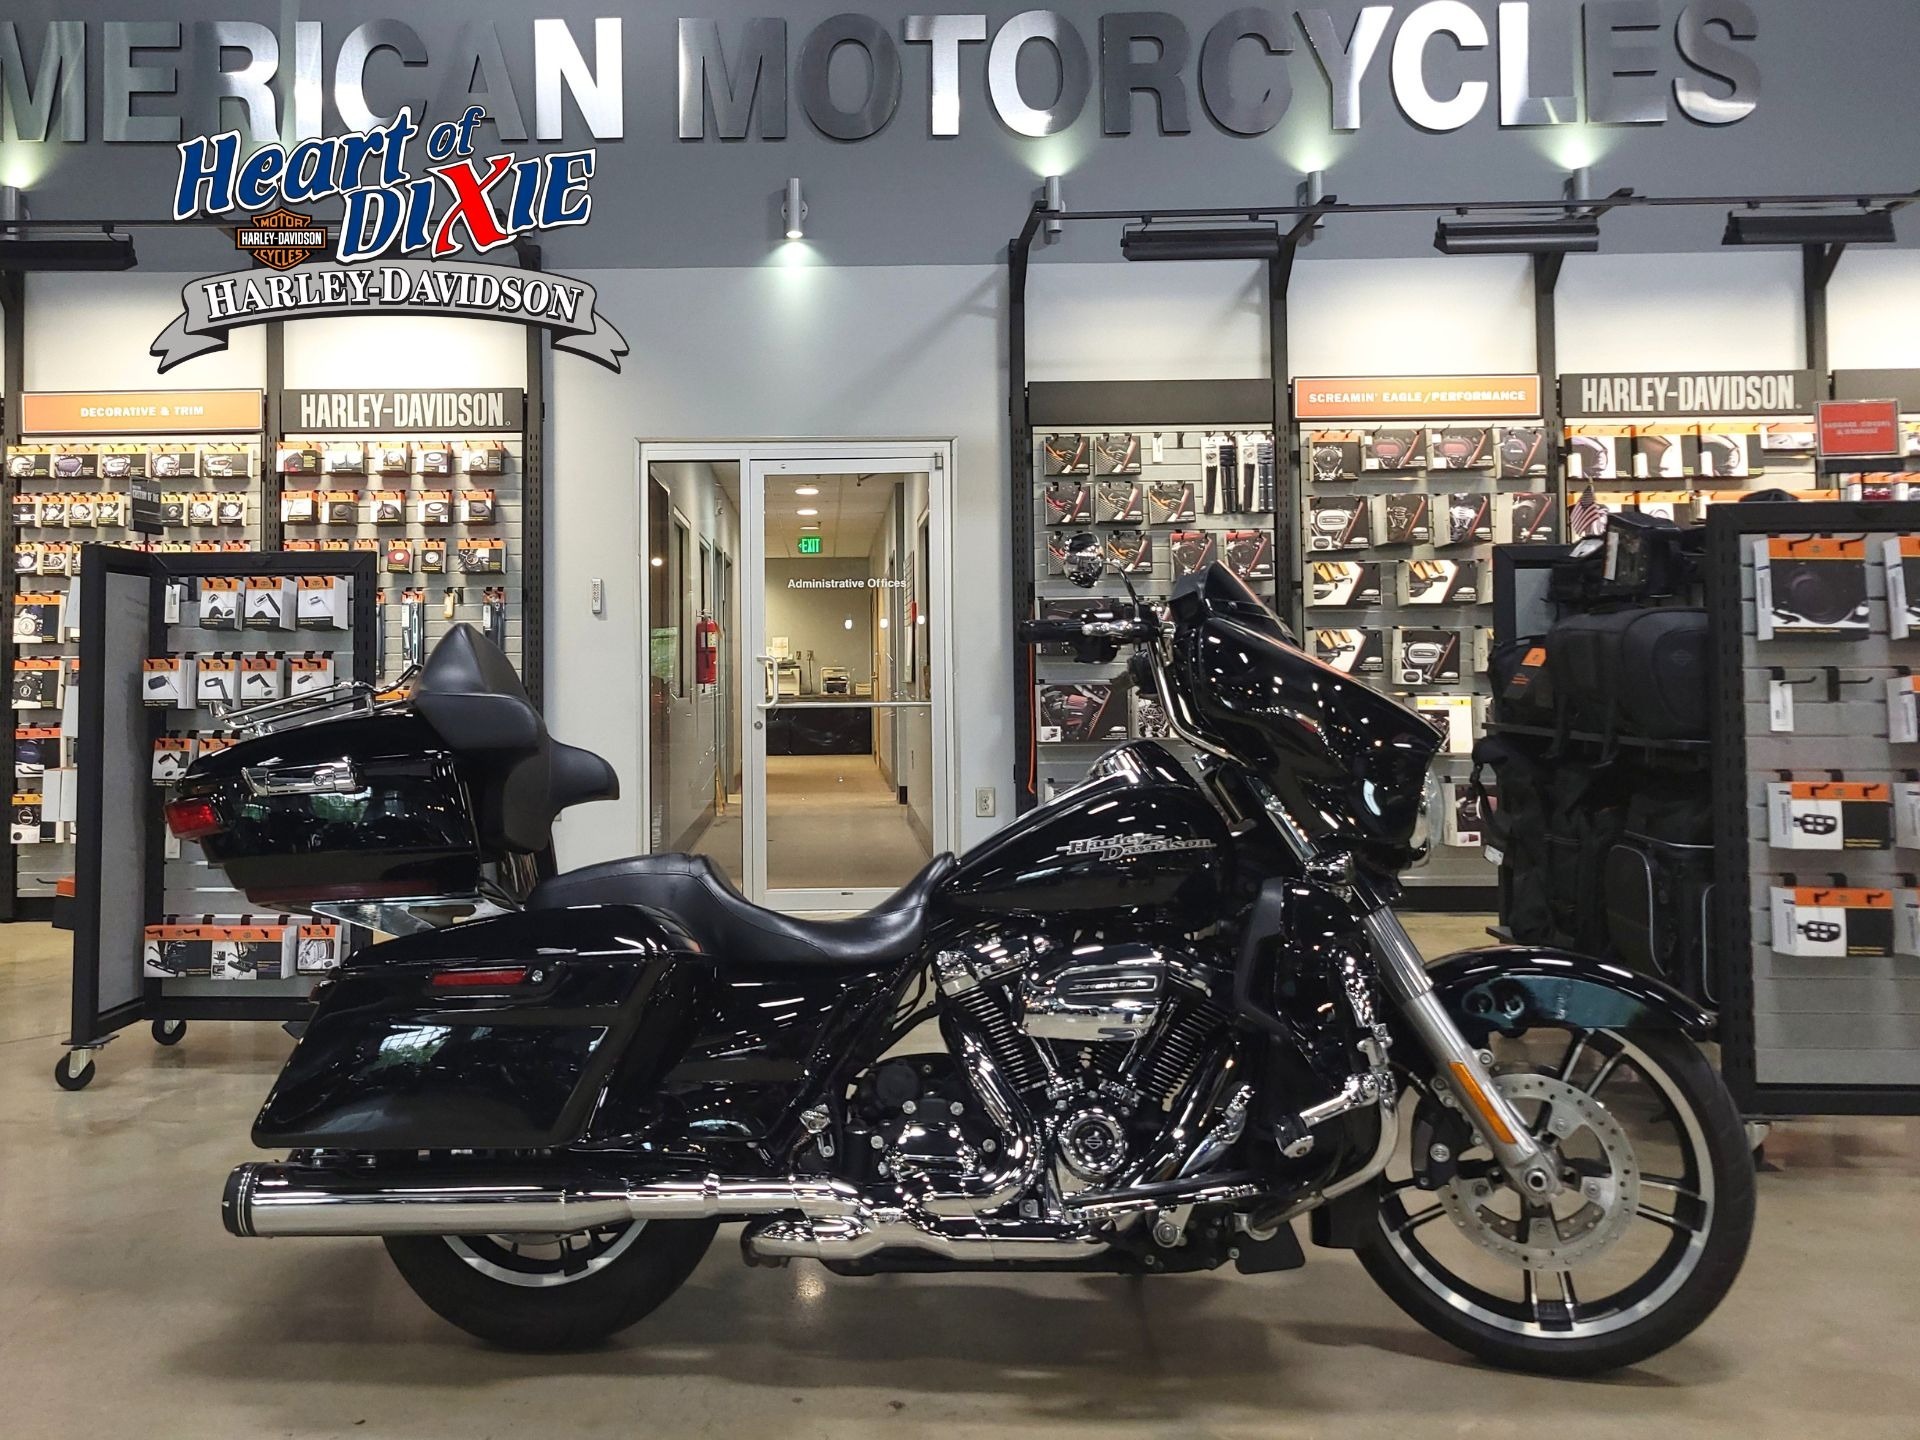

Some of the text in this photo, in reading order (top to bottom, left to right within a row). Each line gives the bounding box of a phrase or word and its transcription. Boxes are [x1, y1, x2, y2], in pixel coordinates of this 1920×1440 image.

[678, 0, 1761, 139] MOTORCYCLES
[1308, 392, 1378, 404] SCREAMIN'
[1581, 375, 1795, 413] HARLEY-DAVIDSON
[80, 406, 205, 418] DECORATIVE & TRIM
[300, 392, 505, 428] HARLEY-DAVIDSON
[801, 538, 820, 553] EXIT
[787, 577, 907, 589] Administrative Offices
